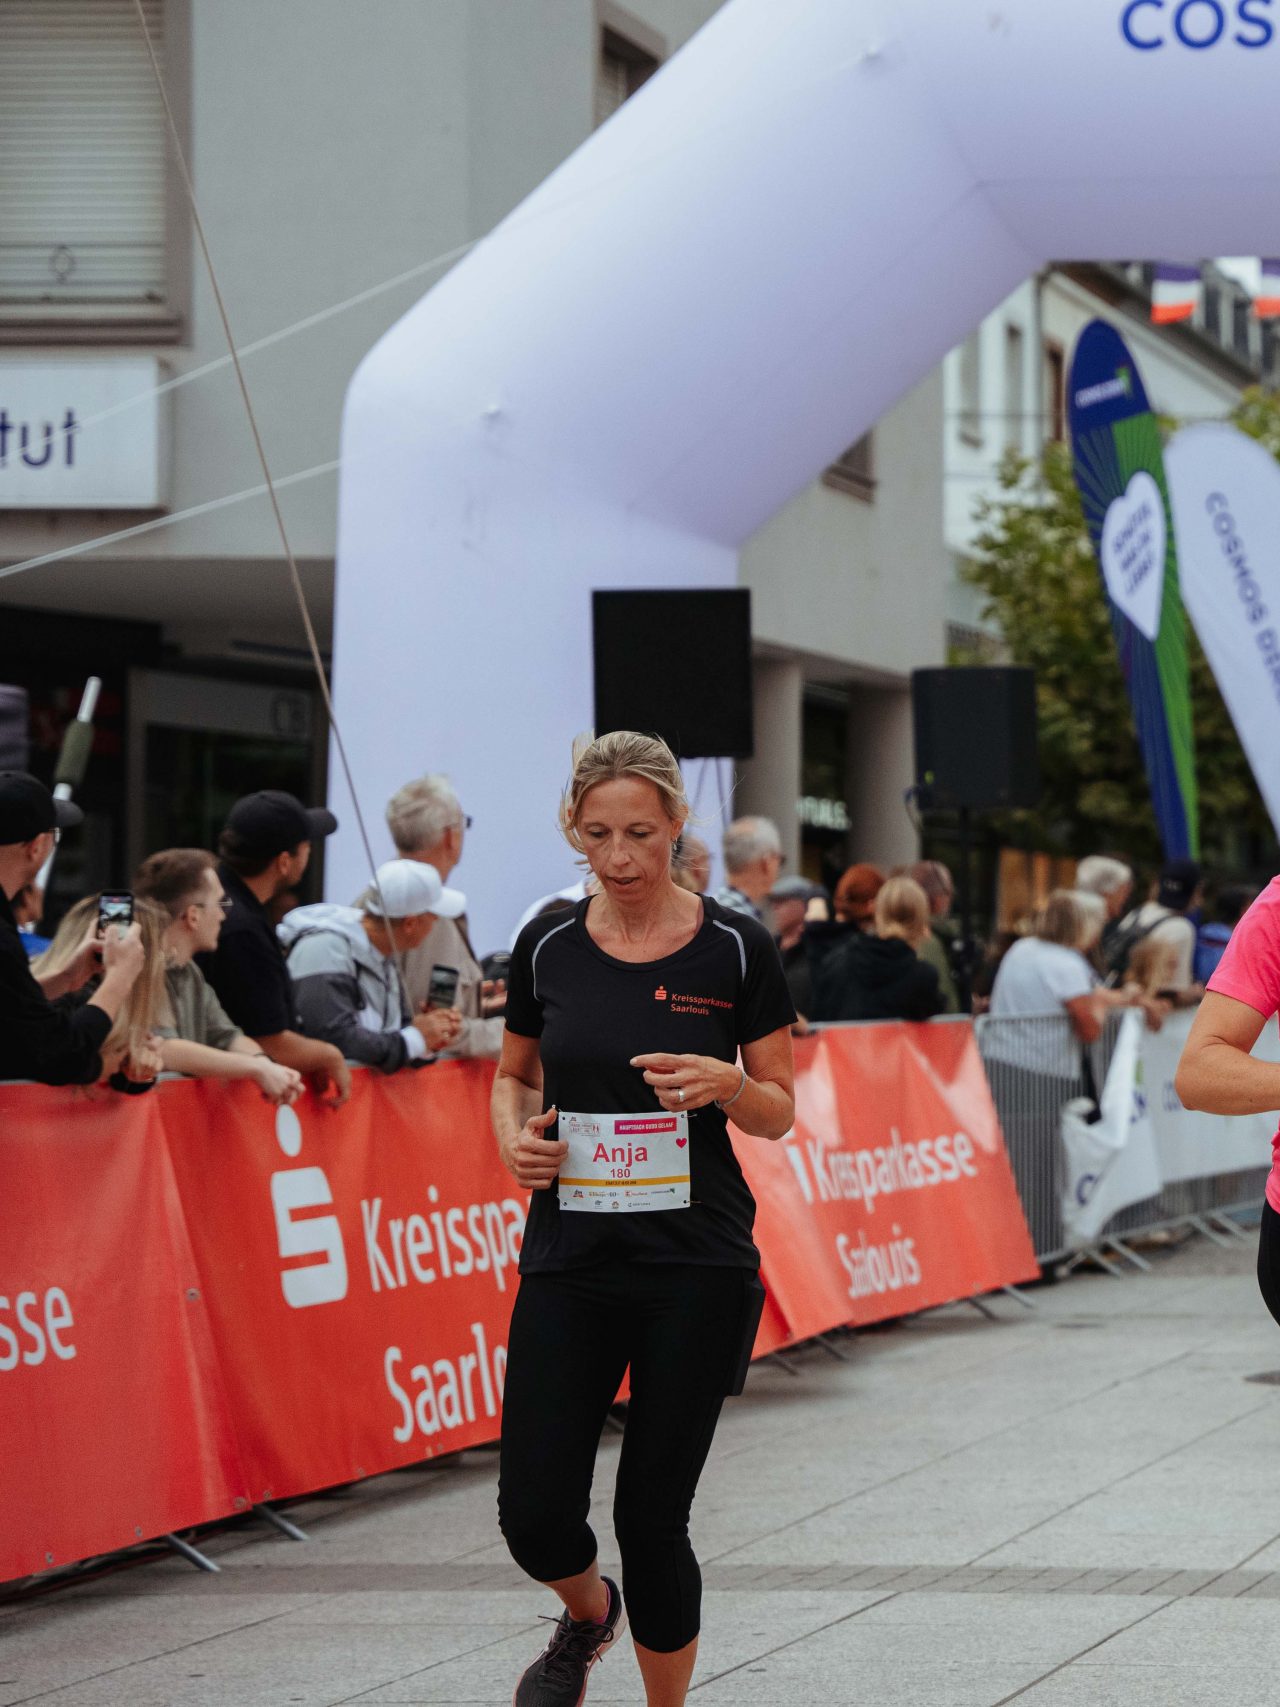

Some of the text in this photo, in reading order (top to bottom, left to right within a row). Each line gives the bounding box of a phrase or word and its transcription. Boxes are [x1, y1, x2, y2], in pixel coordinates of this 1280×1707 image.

[1205, 491, 1269, 626] COSMOS
[671, 993, 734, 1009] Kreissparkasse
[671, 1003, 710, 1015] Saarlouis
[593, 1142, 648, 1167] Anja
[610, 1168, 631, 1178] 180
[360, 1184, 534, 1293] Kreisspa
[0, 1286, 77, 1371] sse
